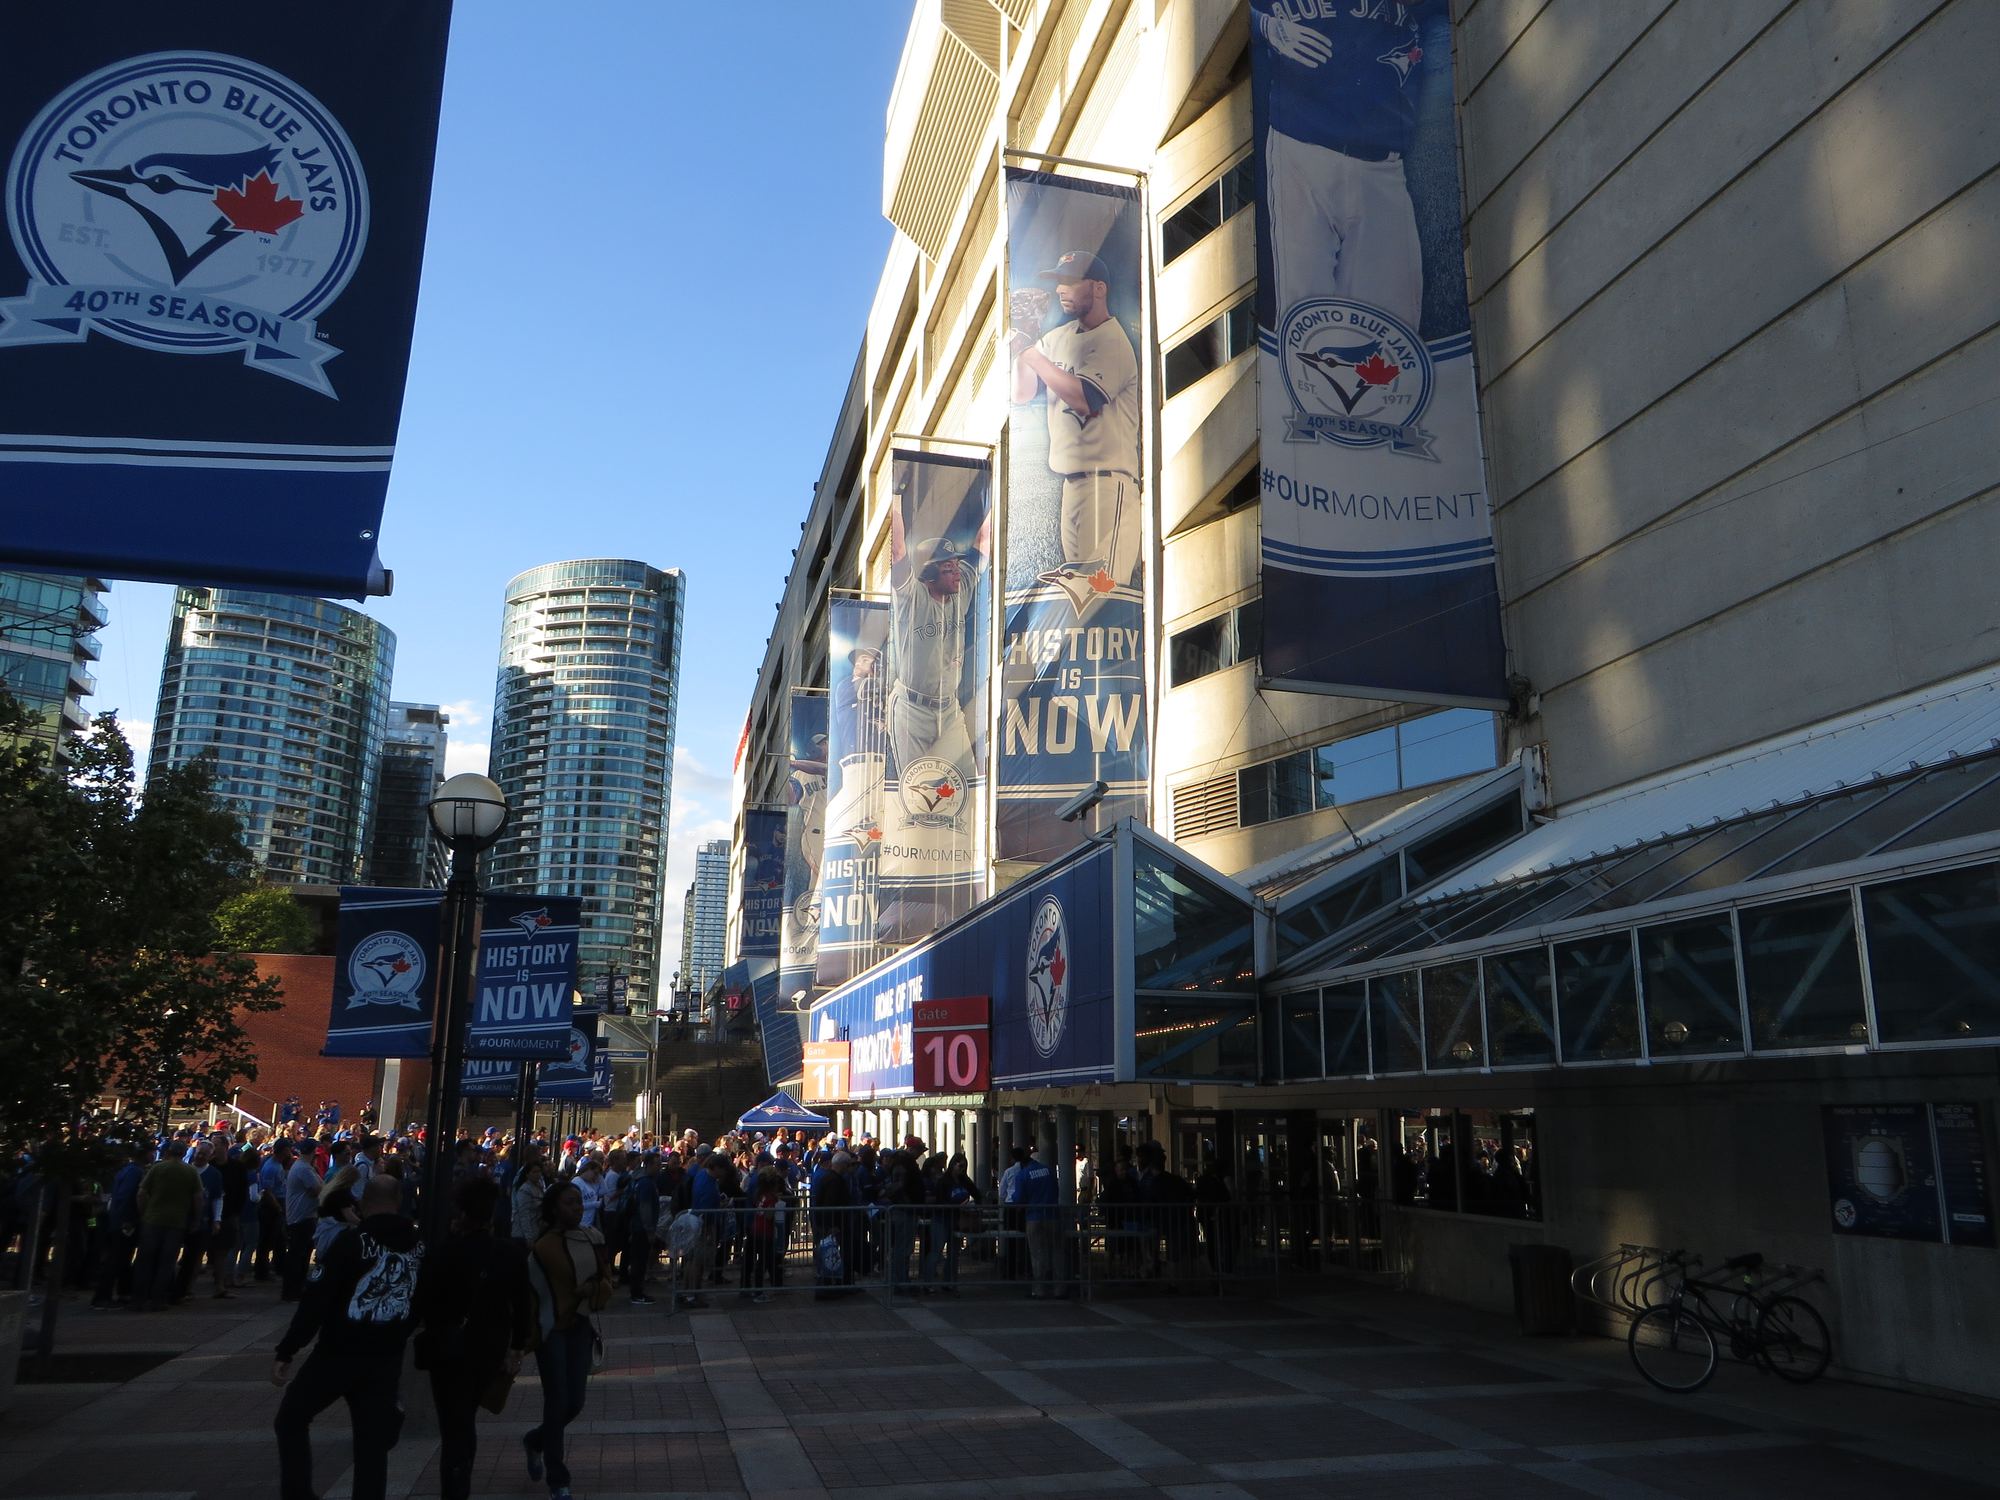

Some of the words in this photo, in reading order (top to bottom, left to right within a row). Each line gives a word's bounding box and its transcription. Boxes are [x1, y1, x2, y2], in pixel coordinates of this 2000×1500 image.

[53, 80, 211, 164] TORONTO
[223, 86, 303, 143] BLUE
[292, 145, 337, 213] JAYS
[58, 223, 110, 249] EST.
[258, 254, 315, 278] 1977
[64, 290, 139, 312] 40TH
[148, 294, 281, 343] SEASON
[1288, 310, 1343, 349] TORONTO
[1350, 313, 1389, 338] BLUE
[1387, 337, 1416, 371] JAYS
[1382, 395, 1412, 405] 1977
[1307, 416, 1335, 429] 40TH
[1339, 419, 1404, 440] SEASON
[1262, 467, 1481, 521] #OURMOMENT
[1010, 627, 1140, 665] HISTORY
[1060, 668, 1082, 690] IS
[1005, 694, 1141, 755] NOW
[905, 762, 933, 784] TORONTO
[926, 814, 954, 823] SEASON
[826, 858, 880, 880] HISTO
[1029, 909, 1057, 962] TORONTO
[358, 937, 390, 962] TORONTO
[391, 938, 410, 950] BLUE
[408, 950, 419, 966] JAYS
[485, 943, 570, 968] HISTORY
[517, 969, 530, 982] IS
[380, 990, 409, 998] SEASON
[480, 982, 567, 1022] NOW
[896, 982, 907, 1014] OF
[908, 974, 924, 1009] THE
[917, 1008, 948, 1020] Gate
[480, 1038, 561, 1049] #OURMOMENT
[853, 1028, 892, 1074] TORONTO
[924, 1034, 978, 1087] 10
[812, 1064, 840, 1098] 11
